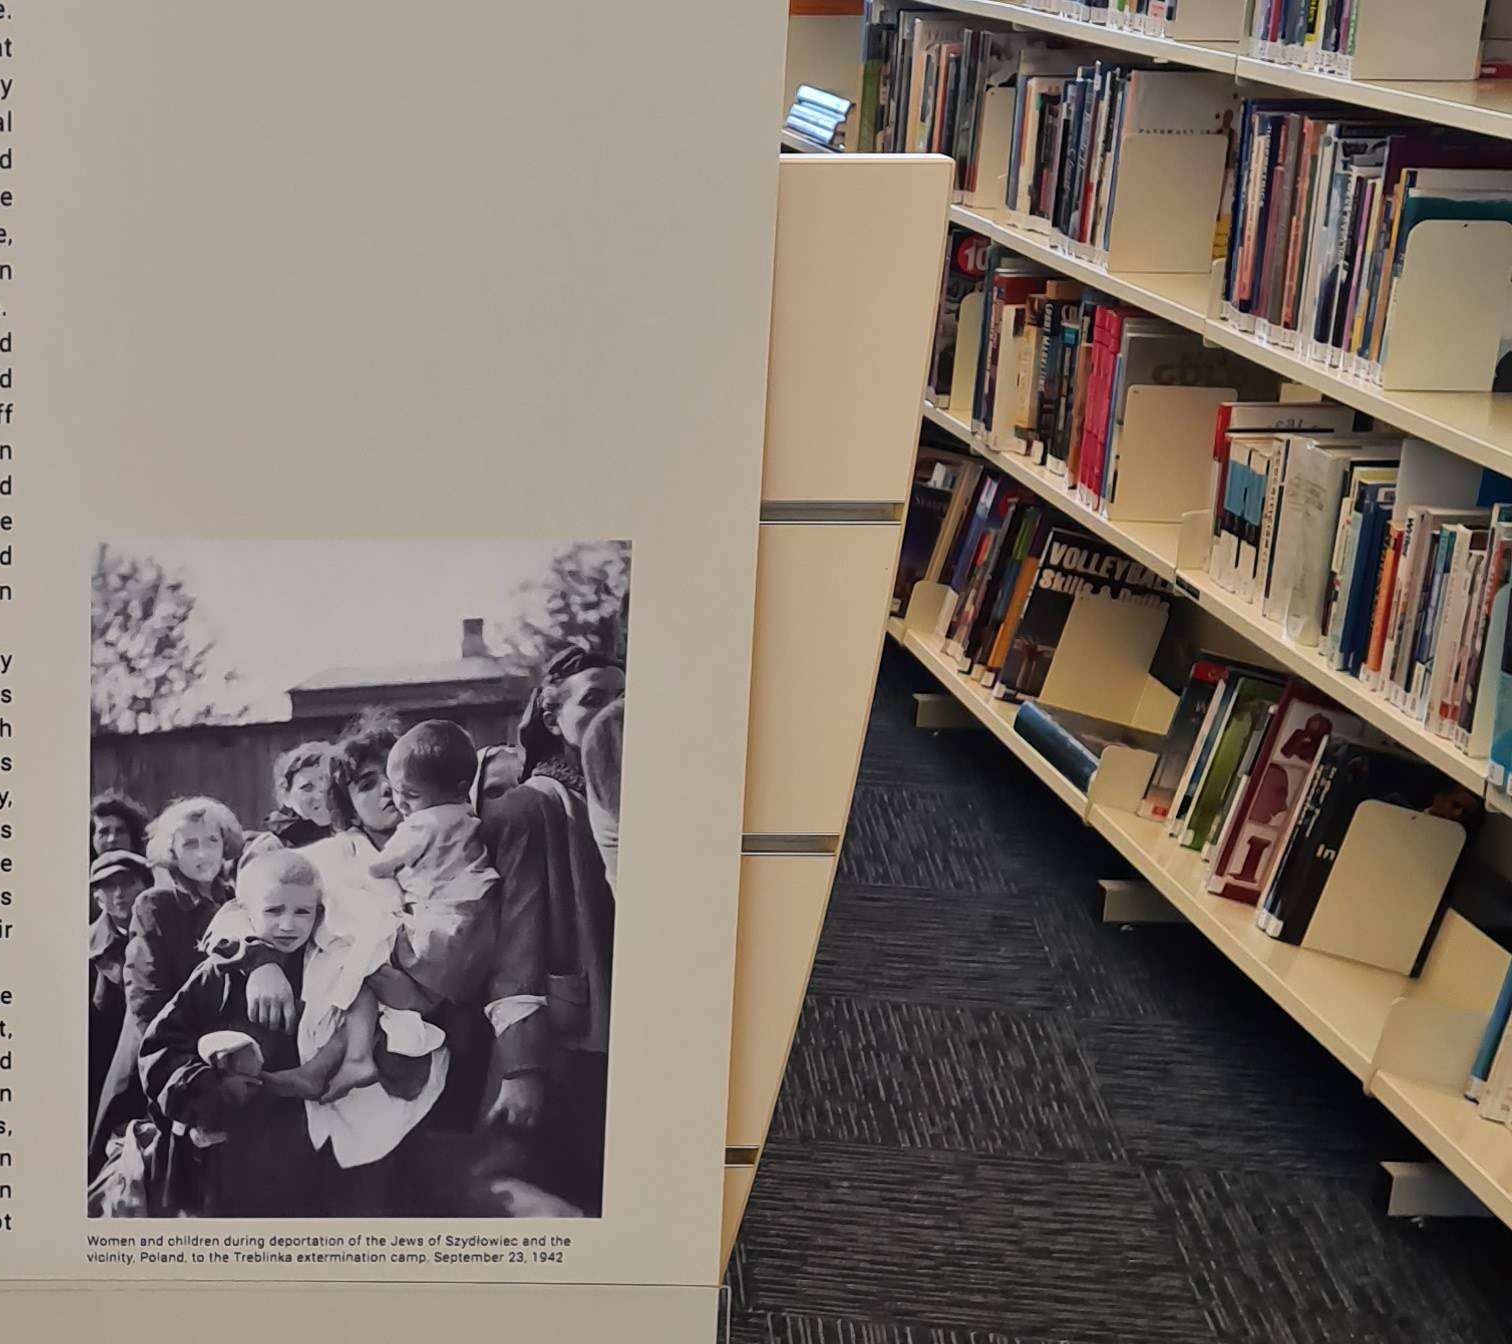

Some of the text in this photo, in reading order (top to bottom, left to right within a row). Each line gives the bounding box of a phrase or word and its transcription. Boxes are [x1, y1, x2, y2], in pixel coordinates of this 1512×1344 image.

[87, 1235, 136, 1247] Women
[140, 1235, 164, 1247] and
[167, 1234, 220, 1247] children
[223, 1235, 265, 1250] during
[268, 1235, 345, 1248] deportation
[347, 1234, 362, 1247] of
[365, 1235, 387, 1247] the
[390, 1235, 424, 1247] Jews
[427, 1234, 442, 1247] of
[522, 1235, 547, 1247] and
[550, 1235, 572, 1247] the
[86, 1251, 136, 1266] vicinity,
[140, 1251, 187, 1264] Poland,
[191, 1252, 205, 1263] to
[208, 1251, 230, 1264] the
[233, 1251, 293, 1263] Treblinka
[296, 1252, 387, 1263] extermination
[433, 1251, 505, 1265] September
[508, 1251, 527, 1264] 23,
[532, 1251, 564, 1264] 1942
